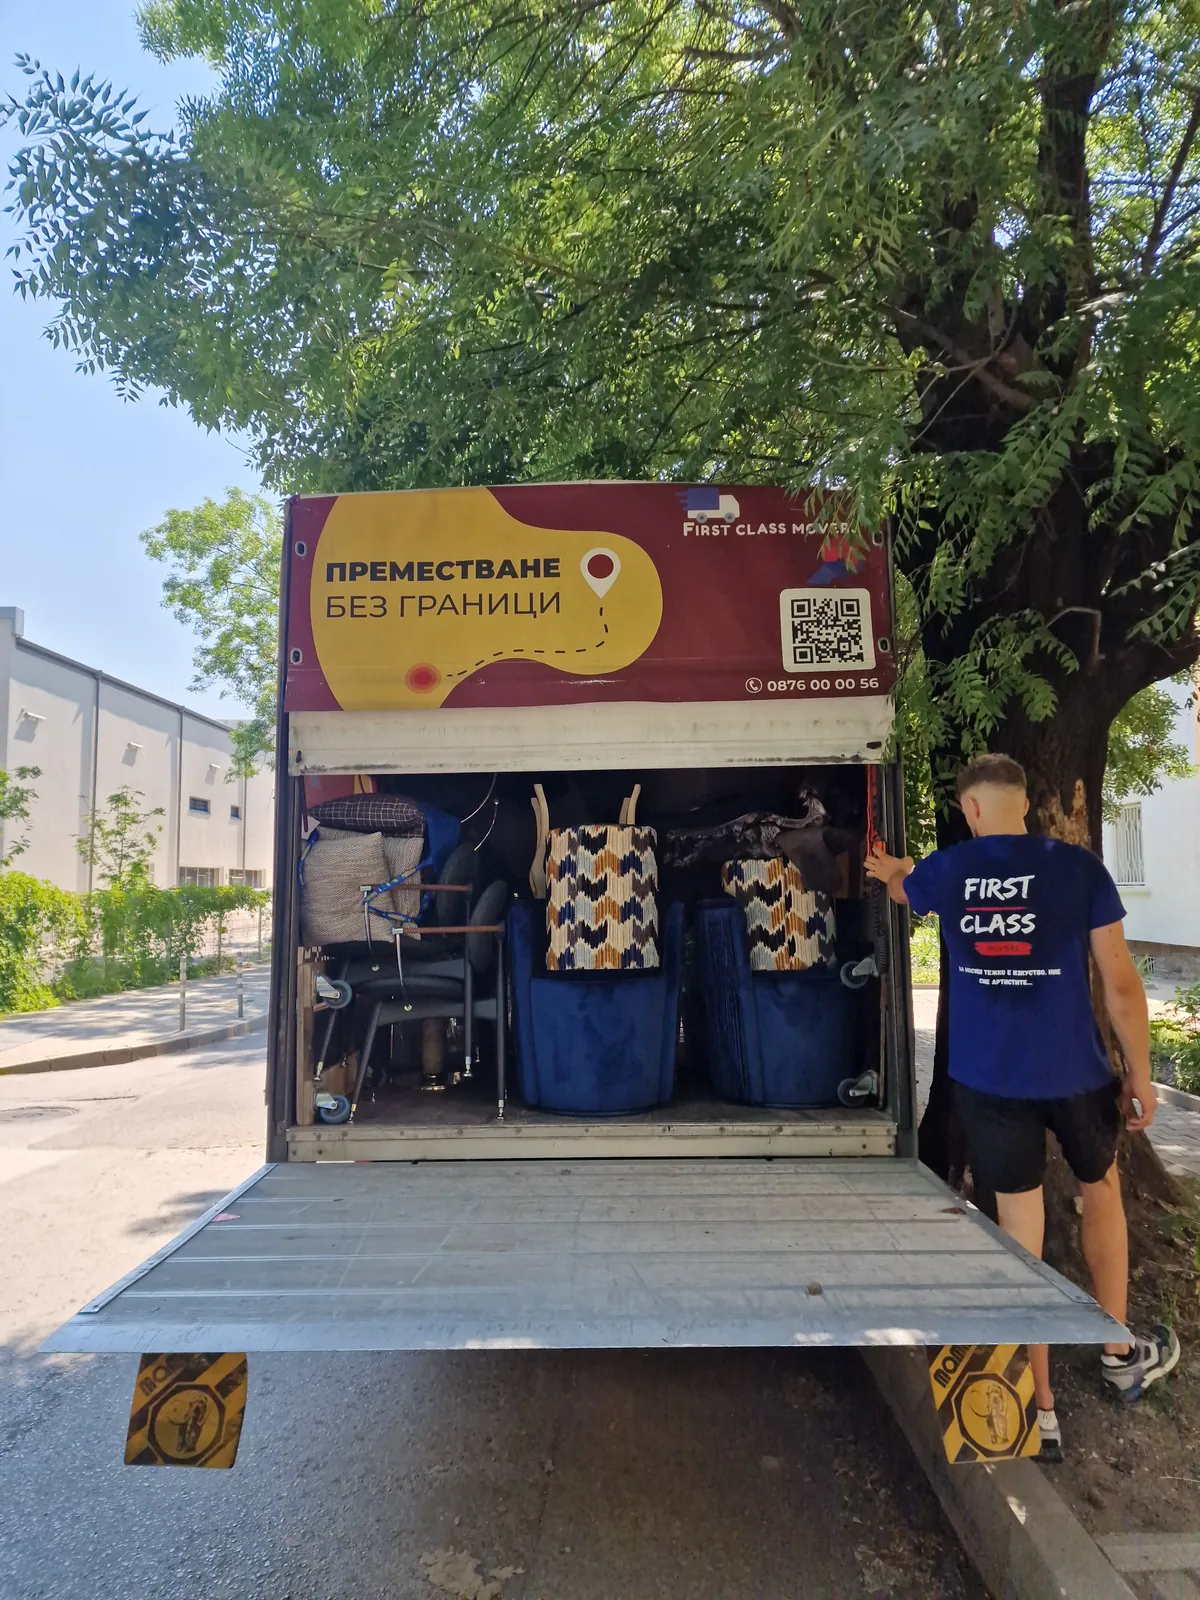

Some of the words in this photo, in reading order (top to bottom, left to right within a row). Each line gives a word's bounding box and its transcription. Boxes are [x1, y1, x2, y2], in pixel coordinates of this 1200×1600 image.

[683, 522, 731, 537] FIRST
[736, 522, 787, 535] CLASS
[326, 558, 561, 582] ПРЕМЕСТВАНЕ
[326, 595, 388, 618] БЕЗ
[400, 592, 561, 618] ГРАНИЦИ
[767, 679, 806, 692] 0876
[810, 679, 831, 691] 00
[835, 678, 856, 690] 00
[860, 677, 880, 689] 56
[964, 874, 1036, 901] FIRST
[960, 913, 1037, 937] CLASS
[984, 969, 1006, 977] ТЕЖКО
